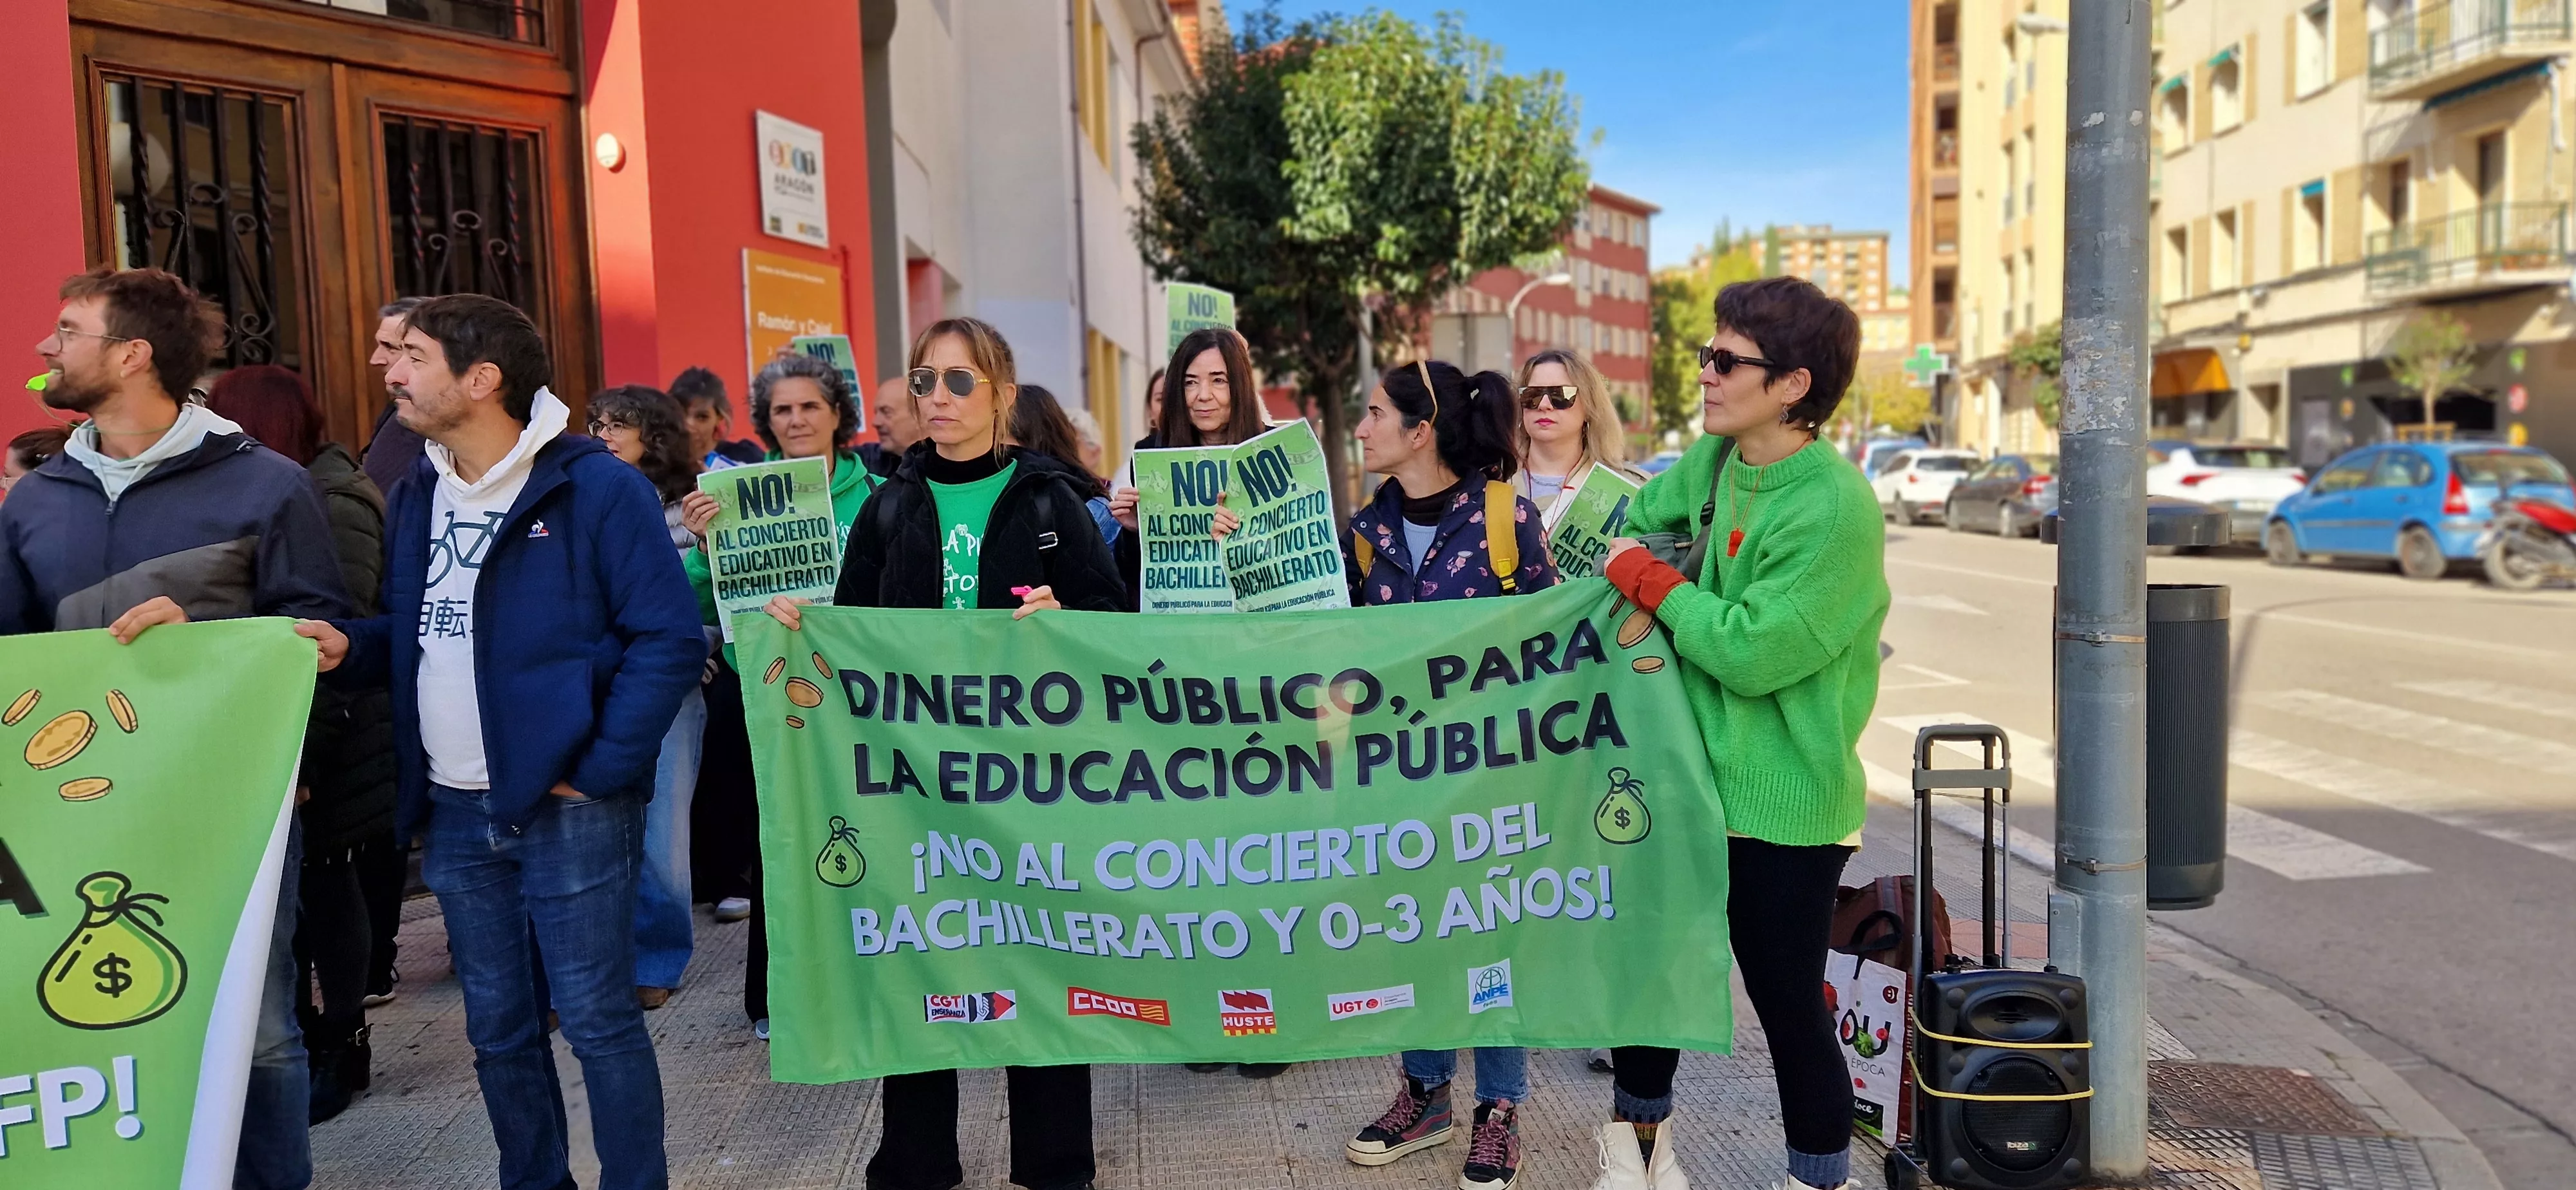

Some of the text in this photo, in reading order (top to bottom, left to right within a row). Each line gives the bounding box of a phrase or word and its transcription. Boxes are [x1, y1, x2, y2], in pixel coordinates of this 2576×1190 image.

[758, 311, 797, 332] Ramón
[1188, 292, 1218, 318] NO!
[1236, 445, 1297, 507] NO!
[736, 473, 795, 520] NO!
[715, 530, 735, 551] AL
[738, 516, 829, 548] CONCIERTO
[1147, 515, 1167, 536] AL
[1227, 490, 1325, 543] AL CONCIERTO
[1227, 519, 1331, 571] EDUCATIVO EN
[1558, 524, 1580, 549] AL
[718, 542, 833, 576] EDUCATIVO EN
[1230, 549, 1338, 600] BACHILLERATO
[718, 565, 835, 600] BACHILLERATO
[838, 617, 1609, 728] DINERO PÚBLICO, PARA
[854, 692, 1630, 804] LA EDUCACIÓN PÚBLICA
[911, 802, 1552, 893] ¡NO AL CONCIERTO DEL
[851, 864, 1616, 959] BACHILLERATO Y 0-3 AÑOS!
[931, 995, 961, 1008] CGT
[1074, 992, 1137, 1016] CCOO
[1332, 1001, 1363, 1014] UGT
[1473, 983, 1508, 1003] ANPE
[1223, 1016, 1274, 1026] HUSTE
[1851, 1056, 1886, 1077] ÉPOCA
